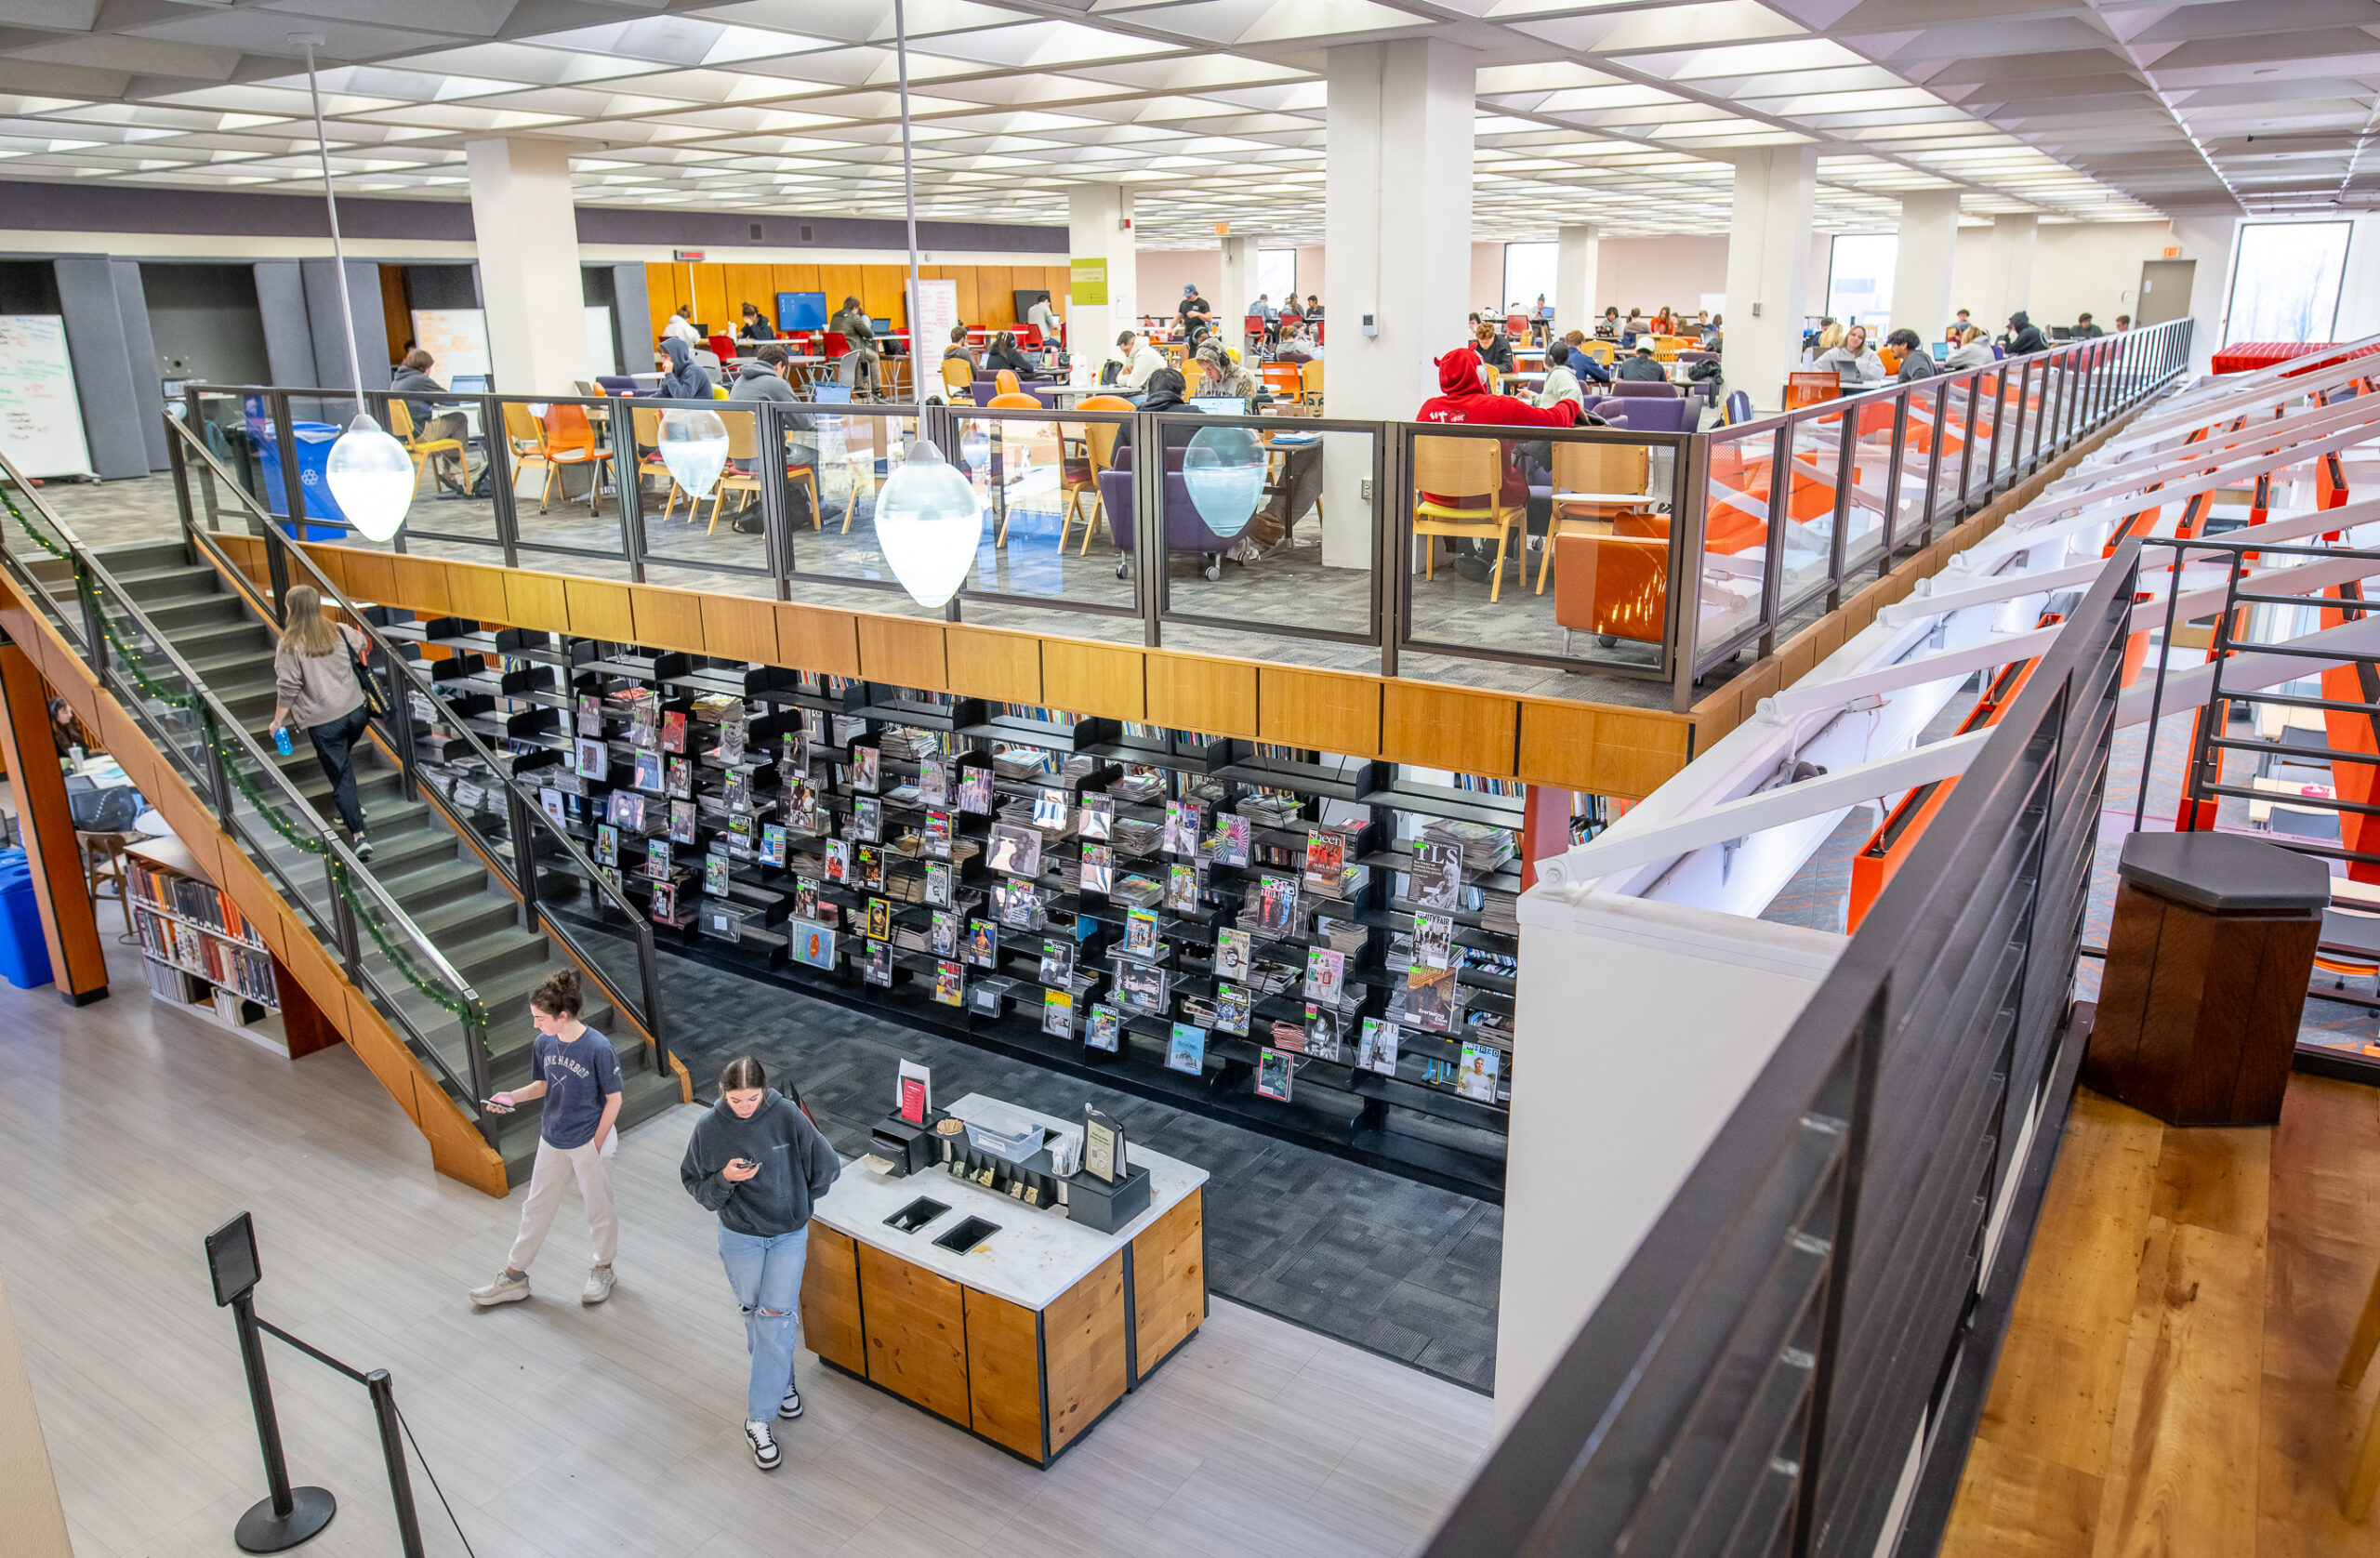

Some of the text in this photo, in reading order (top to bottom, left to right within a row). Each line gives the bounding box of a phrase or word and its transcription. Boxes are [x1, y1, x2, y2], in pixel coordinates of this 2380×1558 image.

[1310, 833, 1342, 846] sheen
[1416, 843, 1458, 865] TLS
[1436, 916, 1450, 926] FAIR
[558, 1056, 590, 1078] HARBOR
